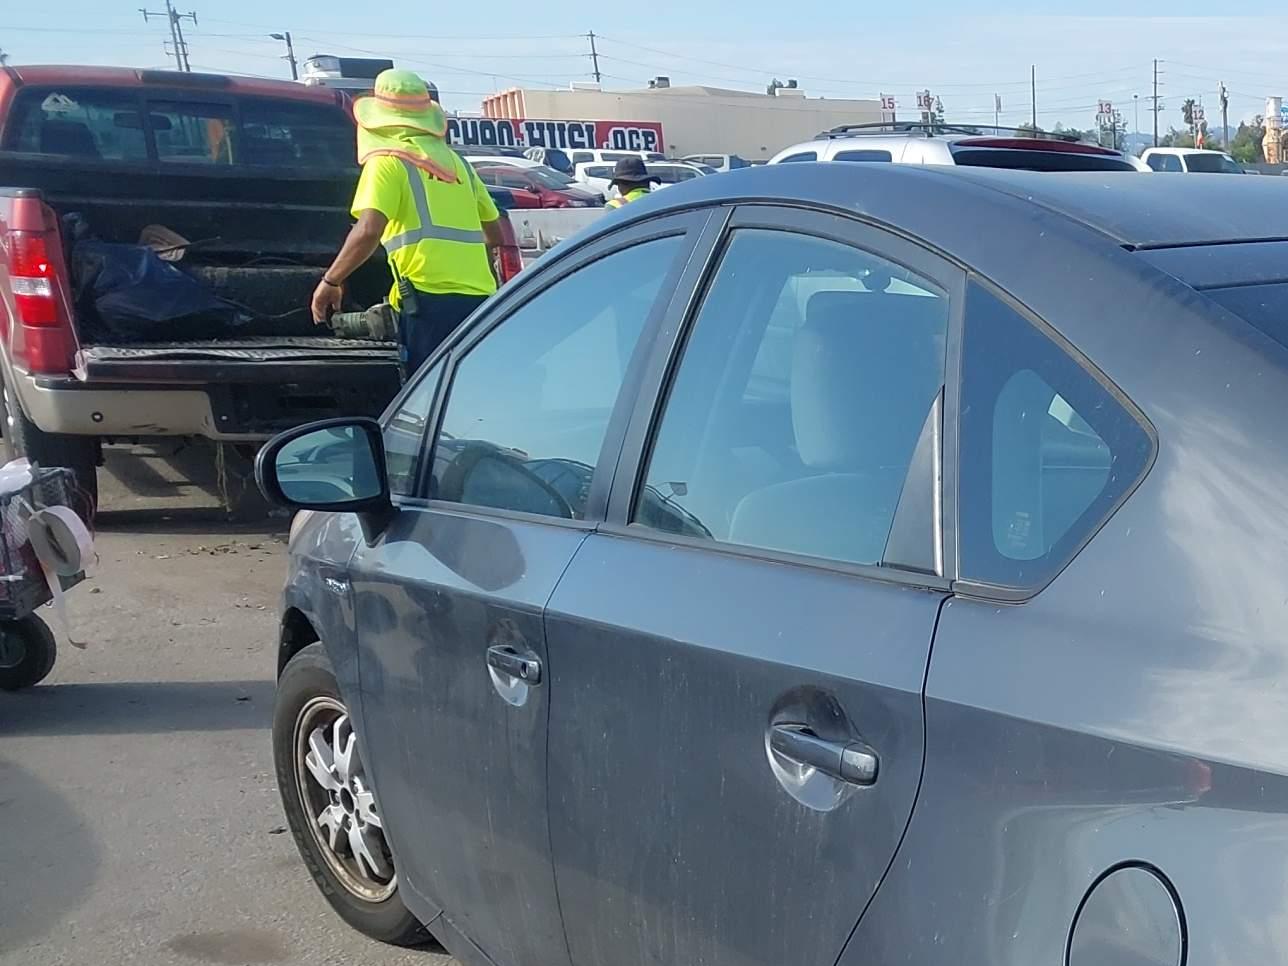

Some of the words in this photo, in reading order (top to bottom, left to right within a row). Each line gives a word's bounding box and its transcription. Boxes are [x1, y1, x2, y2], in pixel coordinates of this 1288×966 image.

[881, 97, 895, 109] 15
[1099, 103, 1112, 114] 13
[1193, 110, 1203, 120] 12
